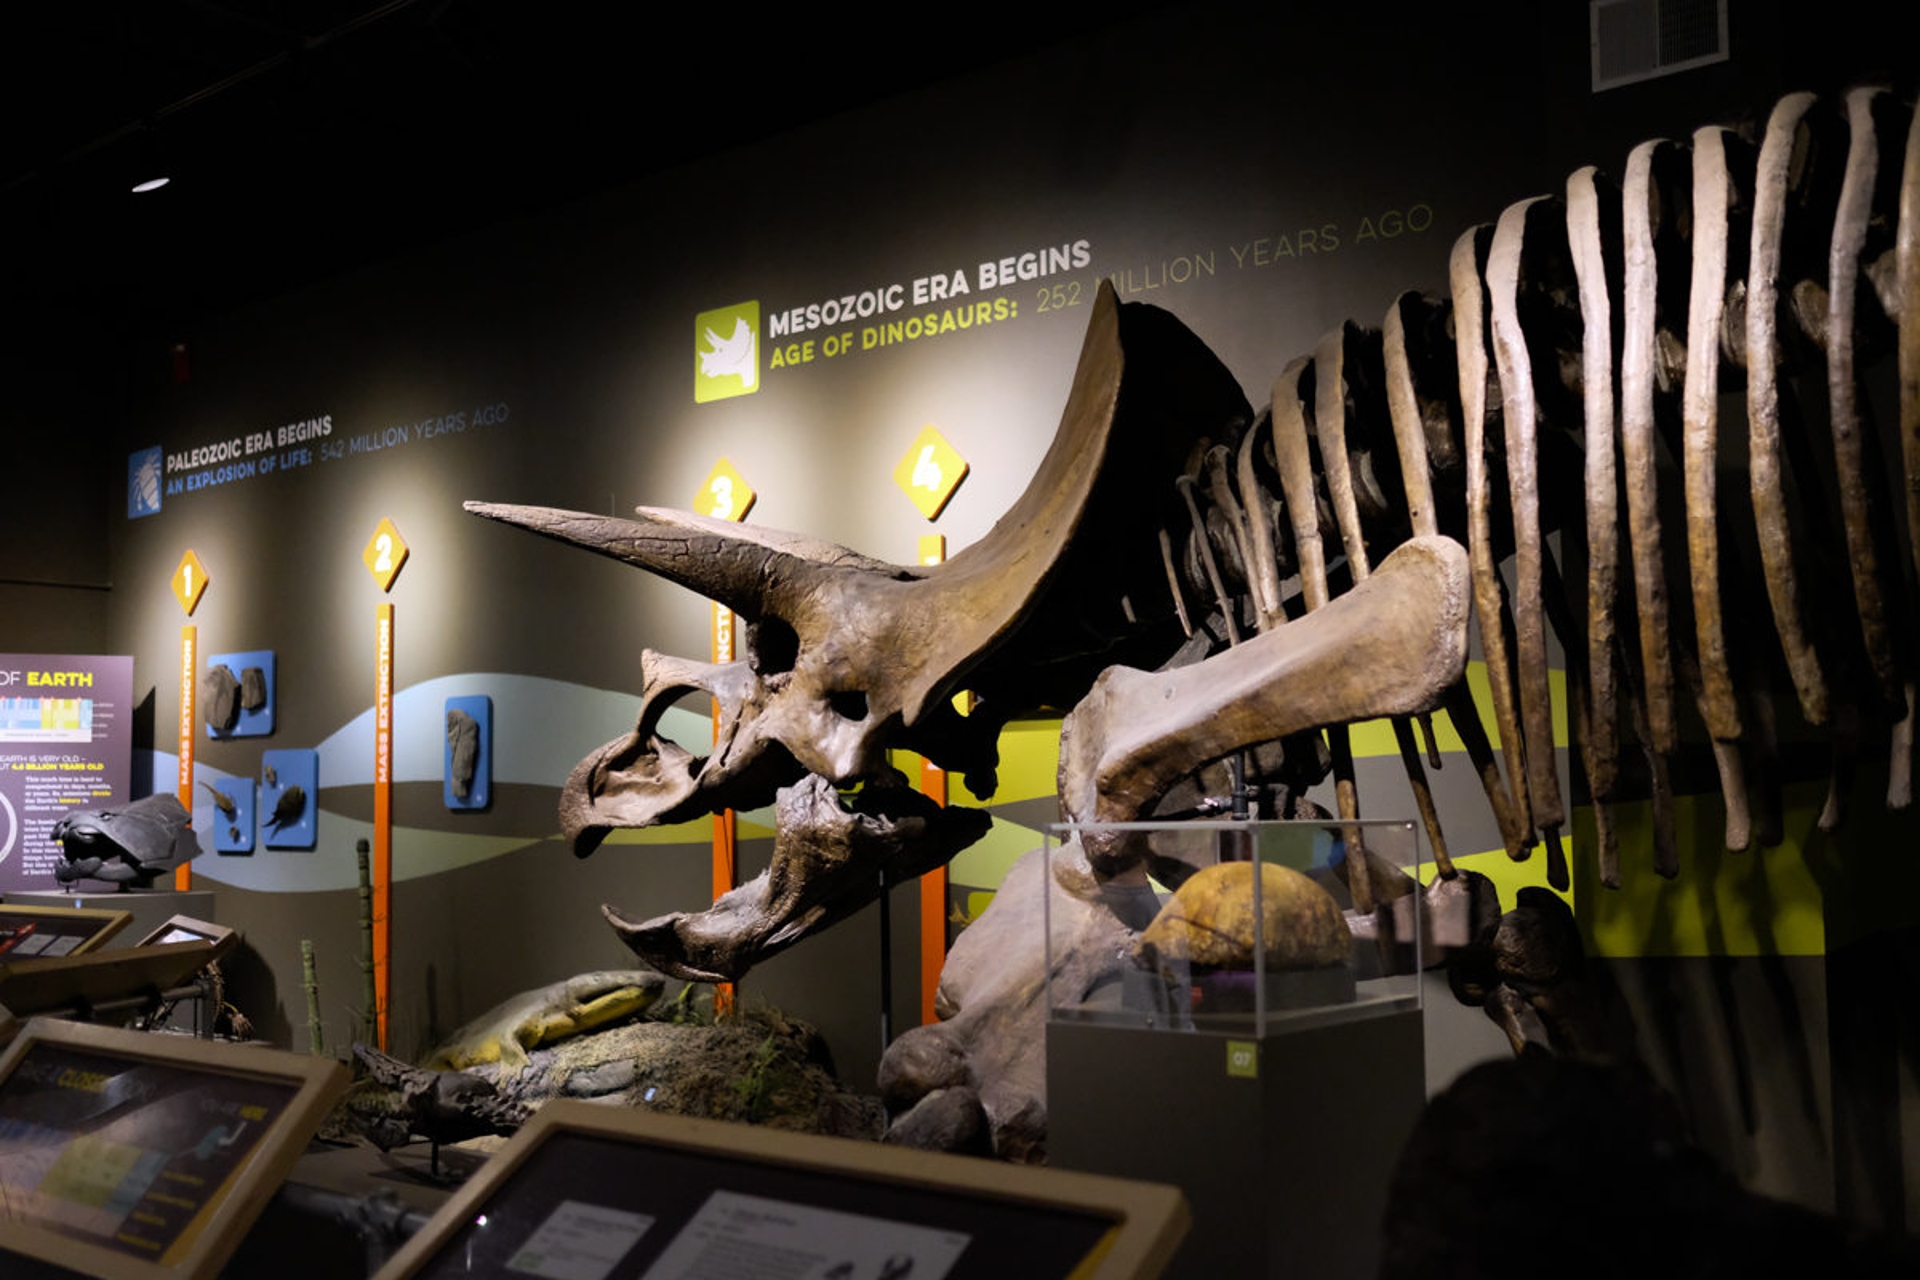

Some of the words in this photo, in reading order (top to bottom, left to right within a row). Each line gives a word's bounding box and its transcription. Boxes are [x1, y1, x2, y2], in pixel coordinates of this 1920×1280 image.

[769, 340, 816, 370] AGE
[822, 331, 854, 358] OF
[861, 297, 1018, 350] DINOSAURS:
[1036, 281, 1082, 313] 252
[1230, 223, 1341, 269] YEARS
[1355, 204, 1433, 244] AGO
[769, 283, 905, 339] MESOZOIC
[912, 269, 971, 306] ERA
[978, 239, 1091, 291] BEGINS
[165, 478, 184, 496] AN
[186, 460, 256, 492] EXPLOSION
[259, 457, 277, 475] OF
[280, 448, 313, 471] LIFE:
[320, 438, 345, 462] 542
[349, 425, 409, 454] MILLION
[414, 411, 467, 440] YEARS
[472, 402, 509, 427] AGO
[166, 438, 242, 474] PALEOZOIC
[245, 430, 274, 456] ERA
[277, 414, 333, 447] BEGINS
[911, 444, 942, 491] 4
[710, 475, 733, 520] 3
[374, 533, 394, 573] 2
[183, 564, 192, 598] 1
[27, 671, 93, 687] EARTH
[182, 639, 192, 737] EXTINCTION
[379, 618, 390, 729] EXTINCTION
[62, 755, 80, 763] OLD
[87, 762, 104, 771] OLD
[181, 740, 190, 785] MASS
[379, 732, 389, 783] MASS
